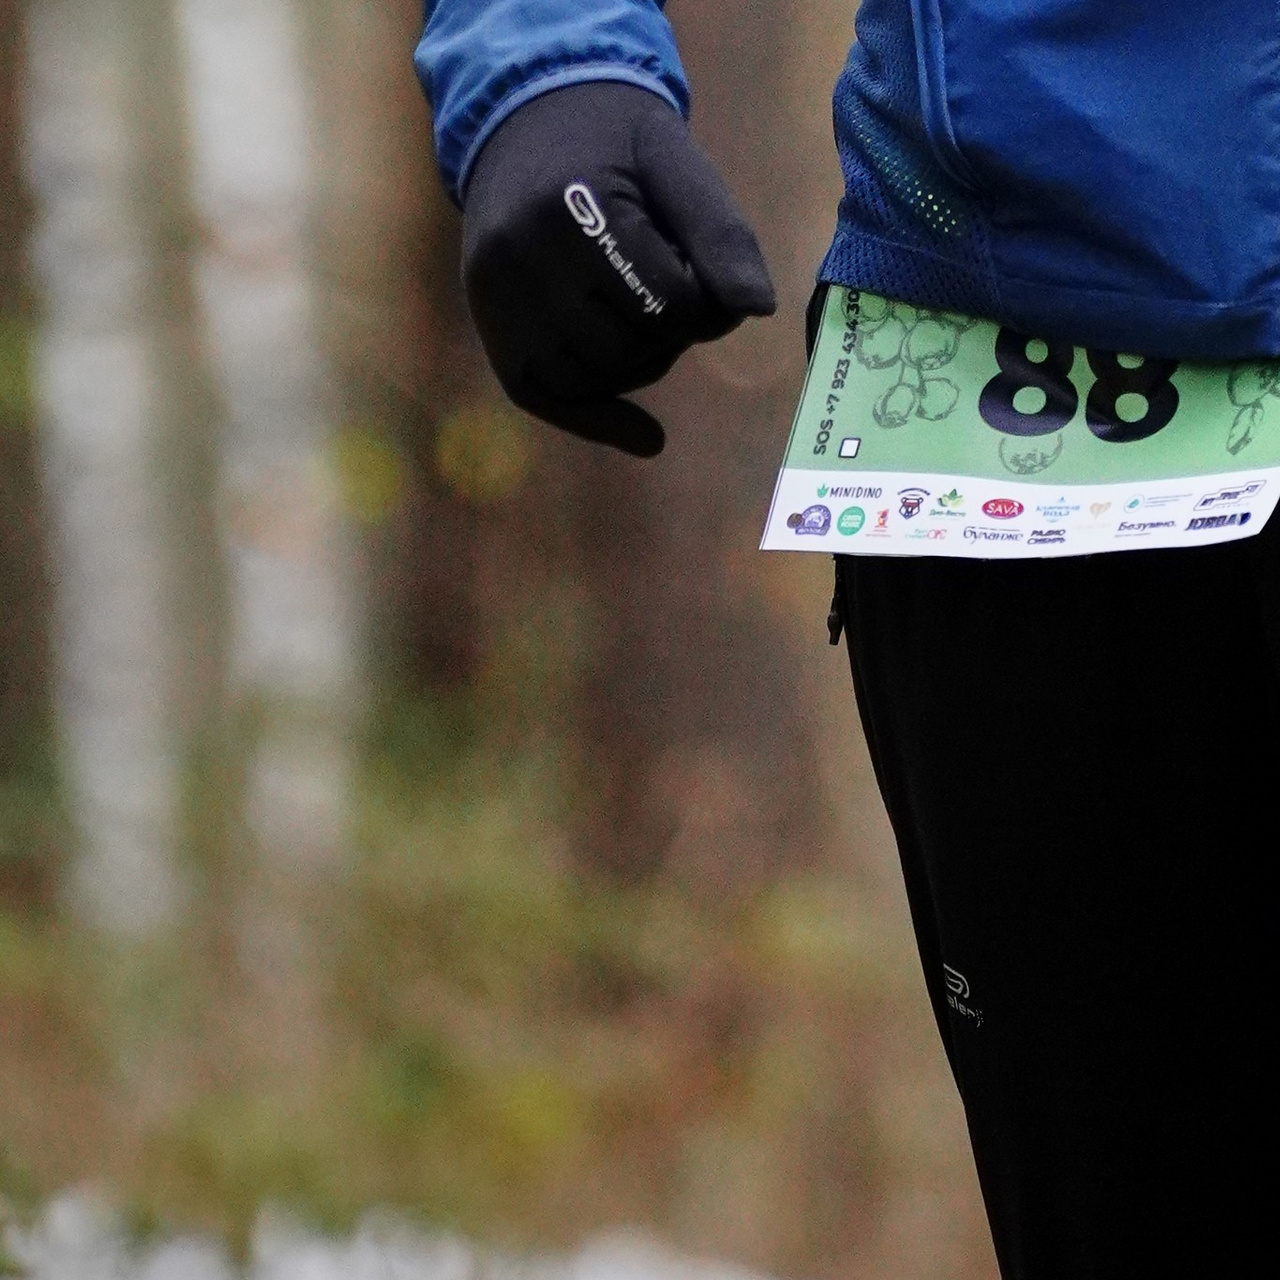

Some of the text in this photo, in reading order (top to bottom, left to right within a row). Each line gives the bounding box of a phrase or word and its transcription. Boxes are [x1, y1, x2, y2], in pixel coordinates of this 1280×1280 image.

[842, 318, 859, 355] 434
[831, 358, 851, 390] 923
[979, 325, 1180, 444] 88
[826, 393, 841, 415] +7
[813, 418, 834, 456] SOS
[829, 486, 883, 499] MINIDINO
